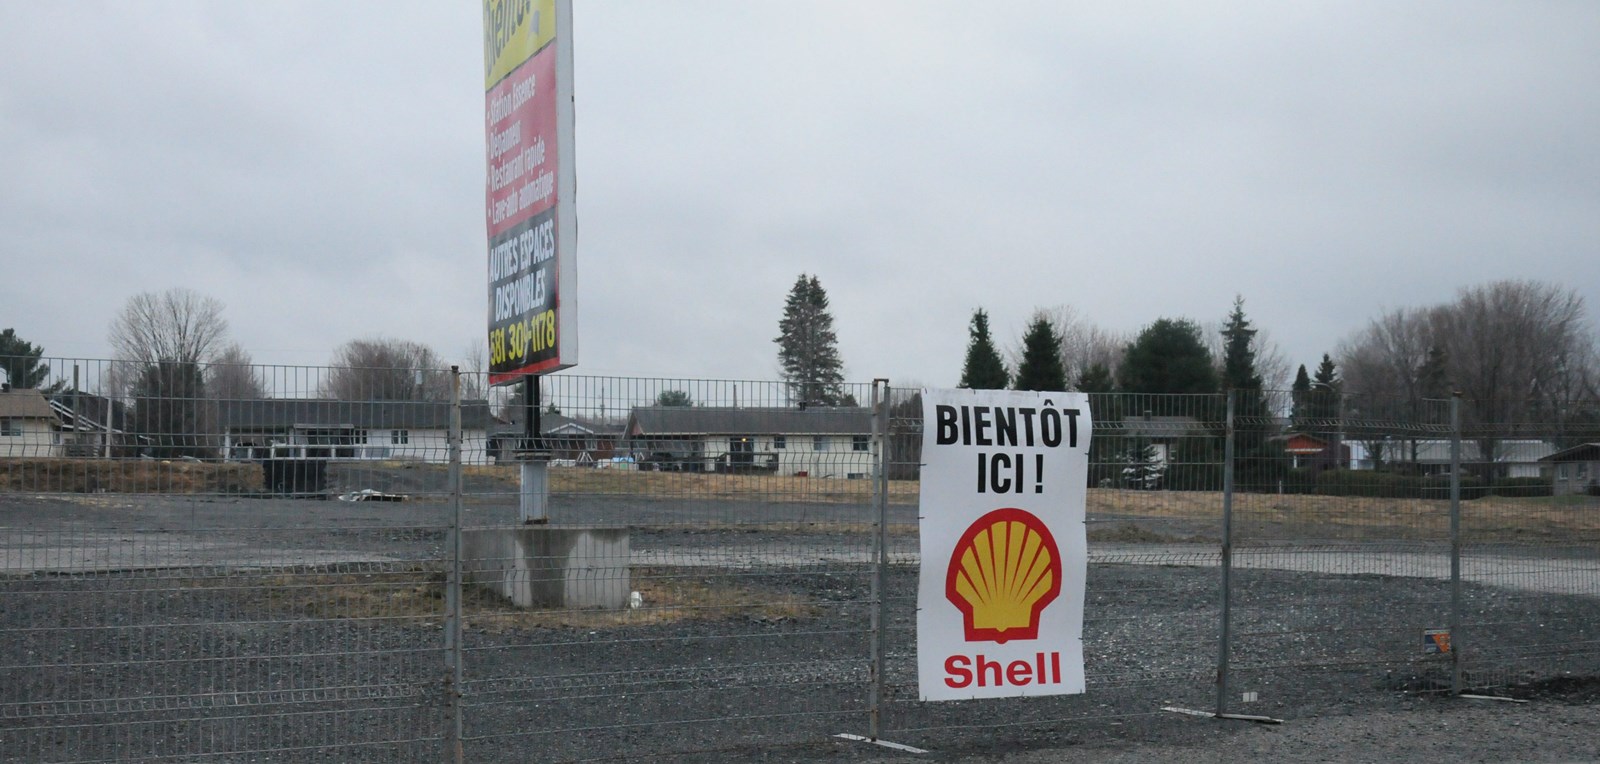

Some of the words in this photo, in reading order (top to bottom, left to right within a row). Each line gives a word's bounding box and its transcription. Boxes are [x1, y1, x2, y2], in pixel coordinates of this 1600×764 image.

[485, 0, 531, 77] Bient
[490, 91, 512, 127] Station
[512, 73, 536, 111] Essence
[491, 148, 524, 193] Restaurant
[524, 135, 545, 175] rapide
[519, 169, 554, 203] automatique
[489, 236, 519, 283] AUTRES
[519, 218, 555, 271] ESPACES
[495, 267, 546, 322] DISPONIBLES
[489, 326, 506, 366] 581
[935, 398, 1081, 448] BIENTÔT
[977, 453, 1024, 494] ICI
[944, 652, 1061, 688] Shell
